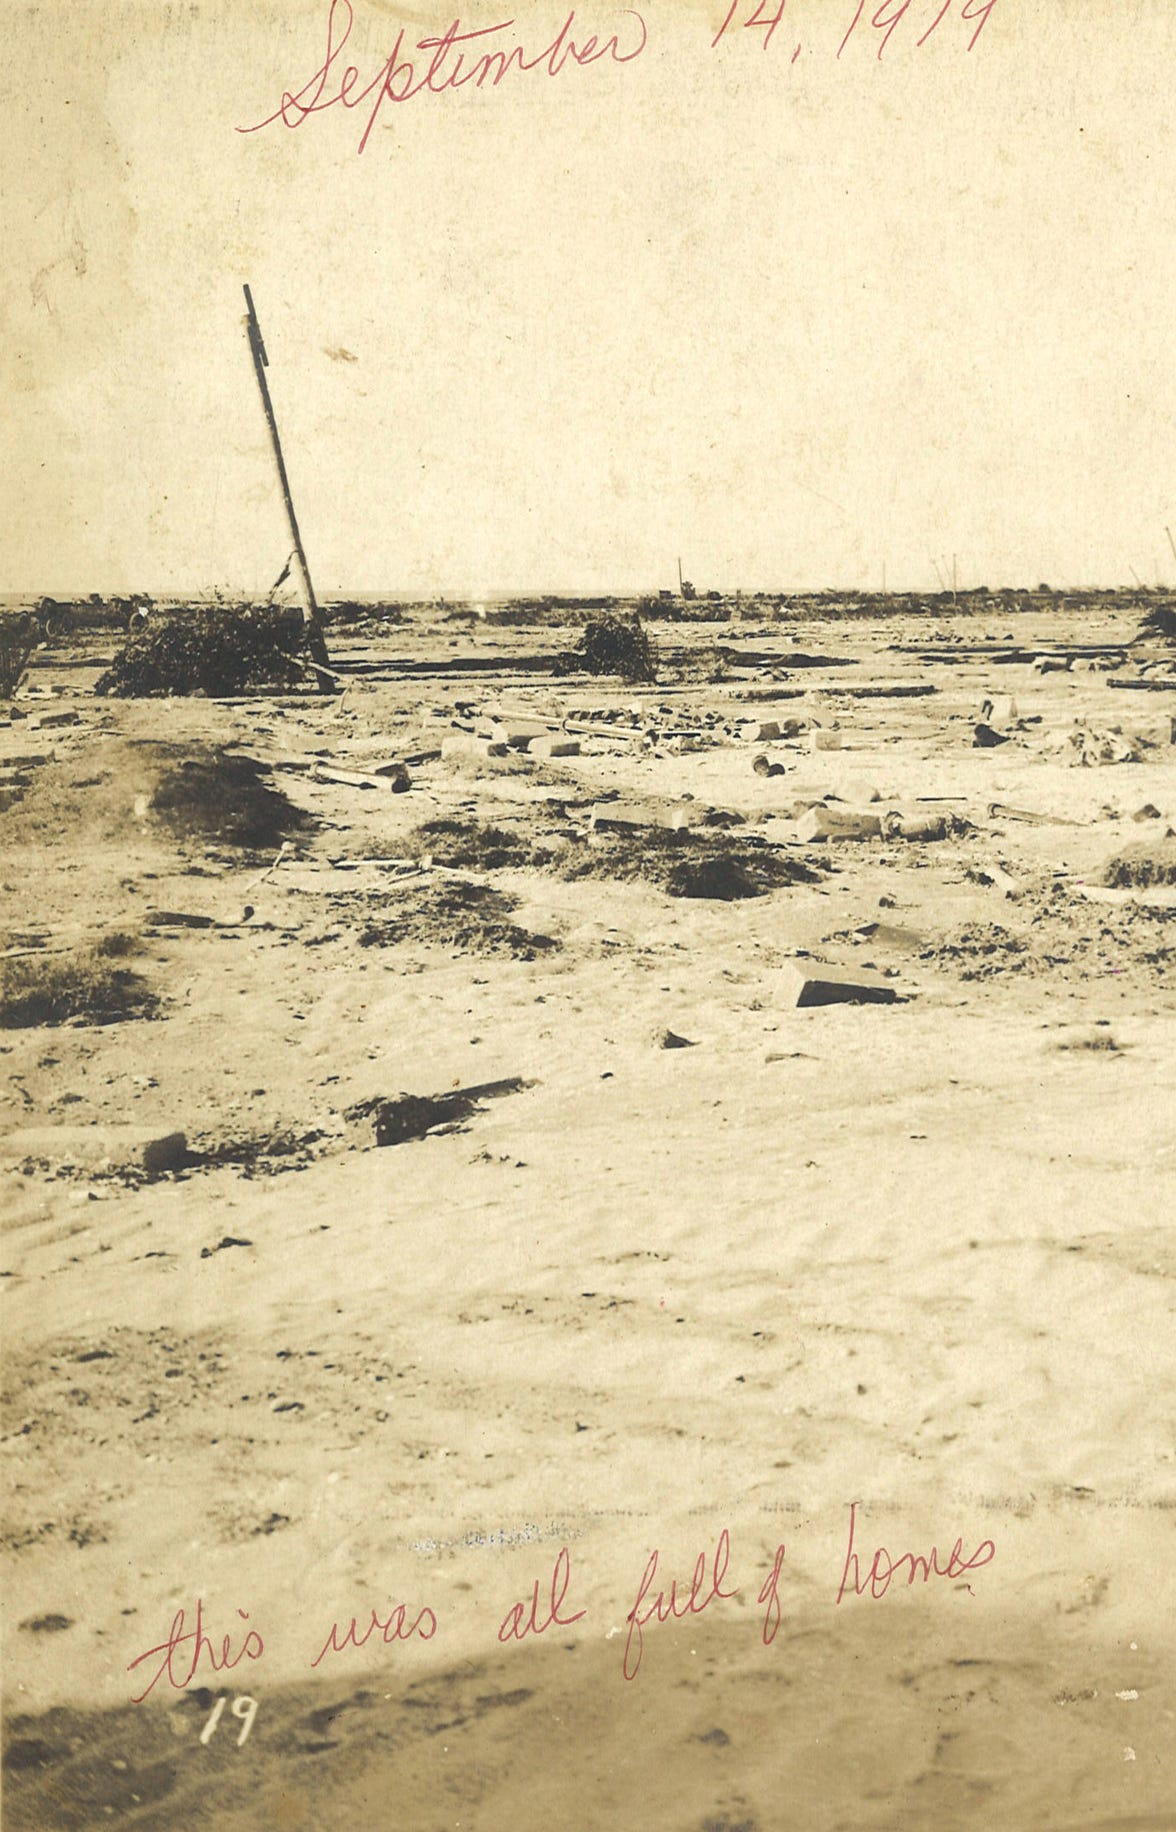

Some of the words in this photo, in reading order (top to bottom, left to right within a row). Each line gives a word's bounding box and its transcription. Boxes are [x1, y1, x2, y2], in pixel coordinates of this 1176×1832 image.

[234, 0, 648, 155] September
[127, 1599, 265, 1704] this
[311, 1604, 438, 1668] was
[497, 1547, 588, 1643] all
[622, 1528, 737, 1681] full
[835, 1502, 996, 1605] homes
